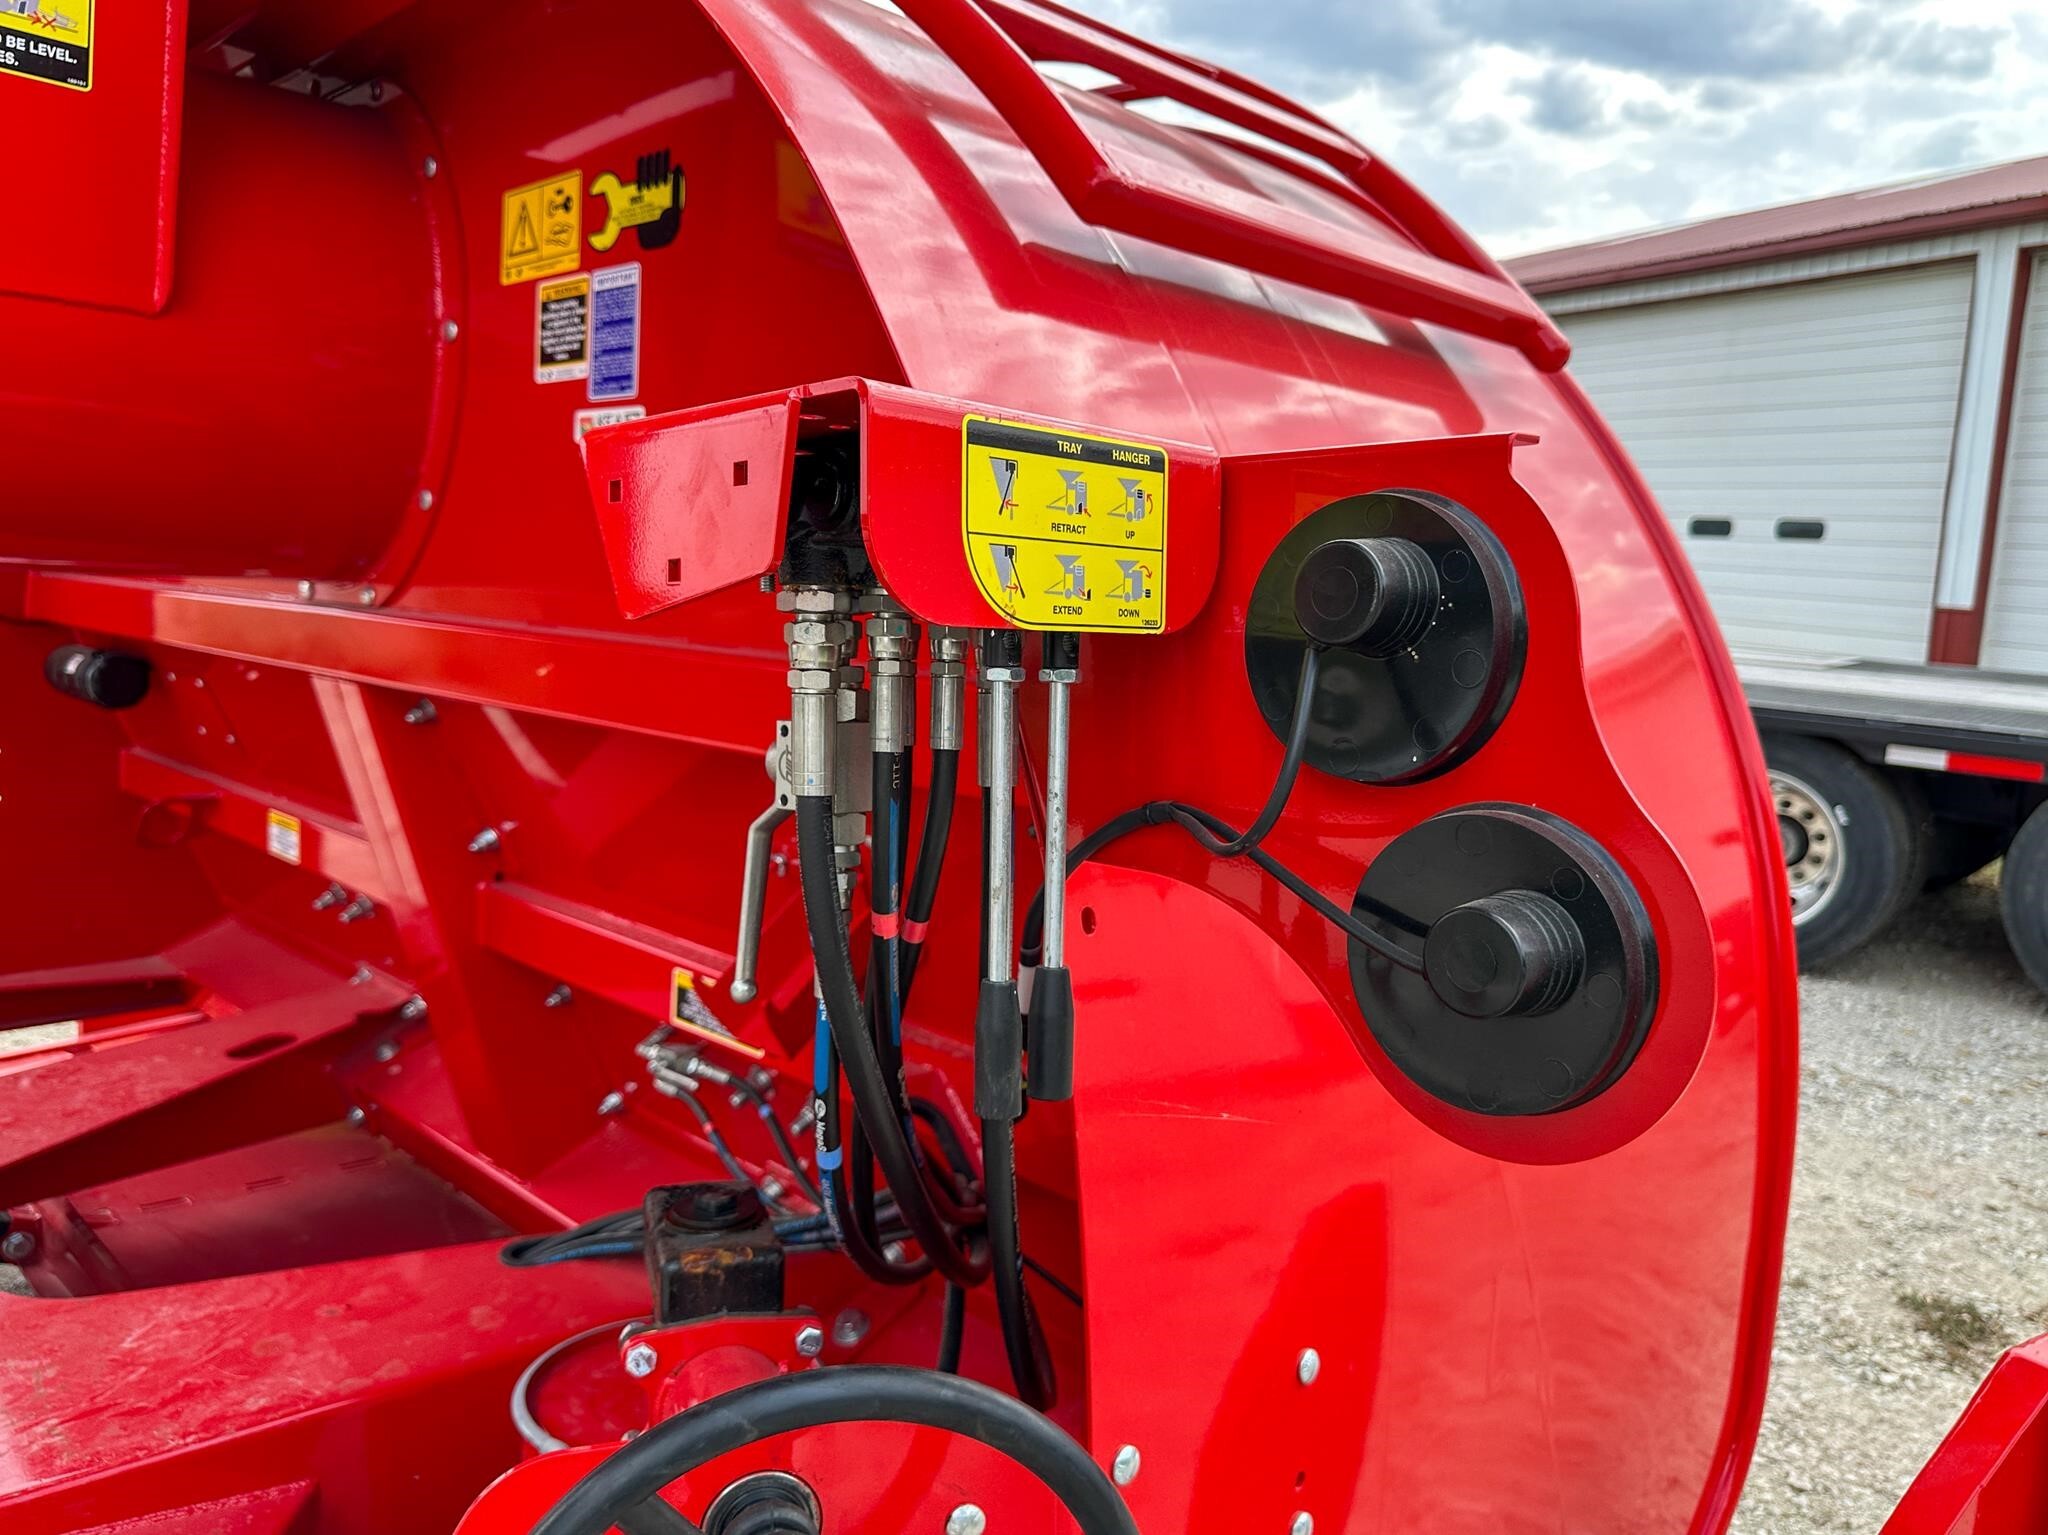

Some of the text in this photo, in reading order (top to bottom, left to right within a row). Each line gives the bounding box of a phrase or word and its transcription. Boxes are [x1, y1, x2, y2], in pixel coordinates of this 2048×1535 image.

[6, 35, 26, 51] BE
[29, 40, 78, 64] LEVEL.
[1057, 440, 1151, 466] TRAY HANGER
[1051, 522, 1135, 539] RETRACT UP
[1053, 605, 1140, 618] EXTEND DOWN
